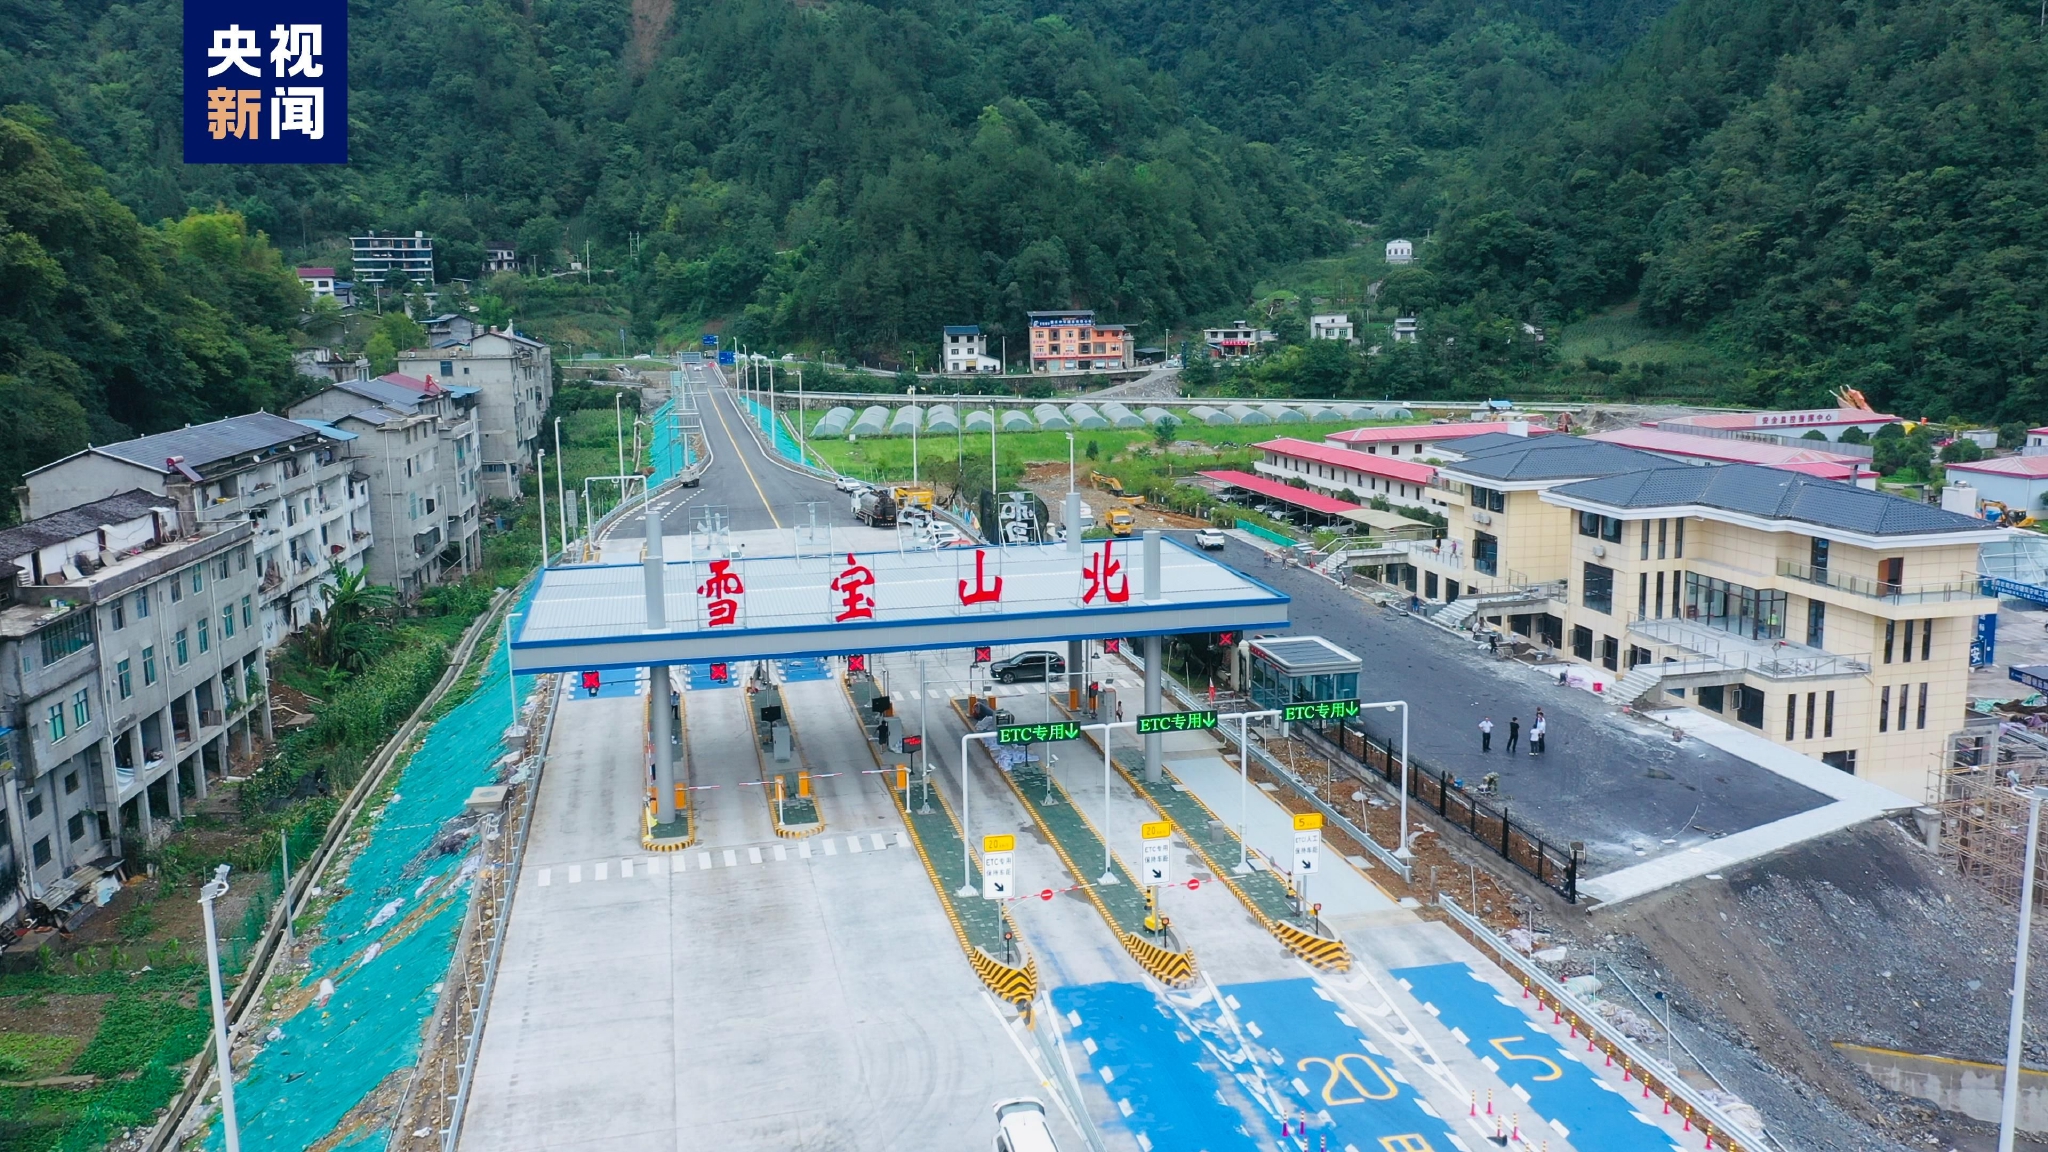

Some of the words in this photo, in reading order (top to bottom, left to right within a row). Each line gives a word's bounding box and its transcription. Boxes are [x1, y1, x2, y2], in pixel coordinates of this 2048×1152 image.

[697, 540, 1129, 627] 雪宝山北
[1285, 702, 1345, 721] ETC专用
[1139, 712, 1202, 732] ETC专用
[1000, 724, 1064, 743] ETC专用
[1146, 826, 1156, 836] 20
[988, 839, 999, 849] 20
[1488, 1036, 1563, 1082] 5
[1296, 1053, 1399, 1106] 20
